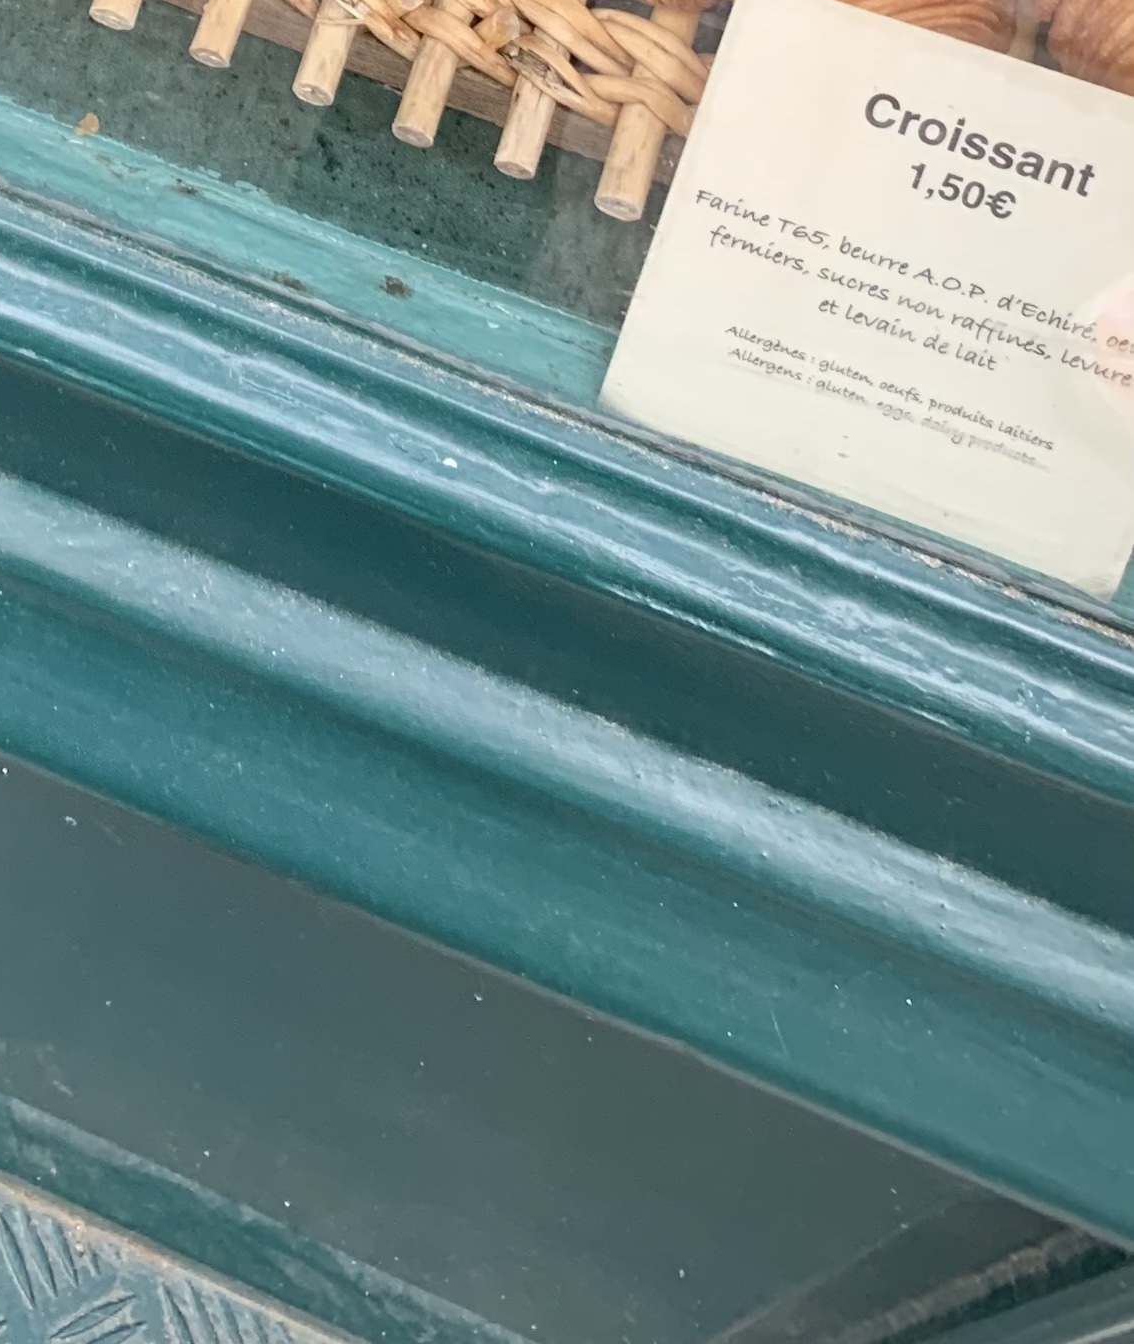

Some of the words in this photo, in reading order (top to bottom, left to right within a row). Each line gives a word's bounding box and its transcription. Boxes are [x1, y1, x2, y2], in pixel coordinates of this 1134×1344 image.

[865, 93, 1095, 197] Croissant
[911, 163, 1016, 219] 1,50€
[696, 190, 770, 227] Farine
[778, 218, 830, 250] T65,
[839, 236, 909, 275] beurre
[912, 268, 988, 303] A.O.P.
[710, 225, 810, 275] fermiers,
[817, 268, 889, 301] sucres
[897, 295, 944, 319] non
[1061, 349, 1133, 388] levure
[818, 300, 839, 315] et
[845, 304, 916, 342] levain
[923, 334, 950, 354] de
[956, 343, 997, 371] lait
[725, 326, 806, 361] Allergènes
[819, 360, 874, 387] gluten,
[928, 399, 994, 429] produits
[998, 421, 1054, 450] laitiers
[728, 348, 802, 381] Allergens
